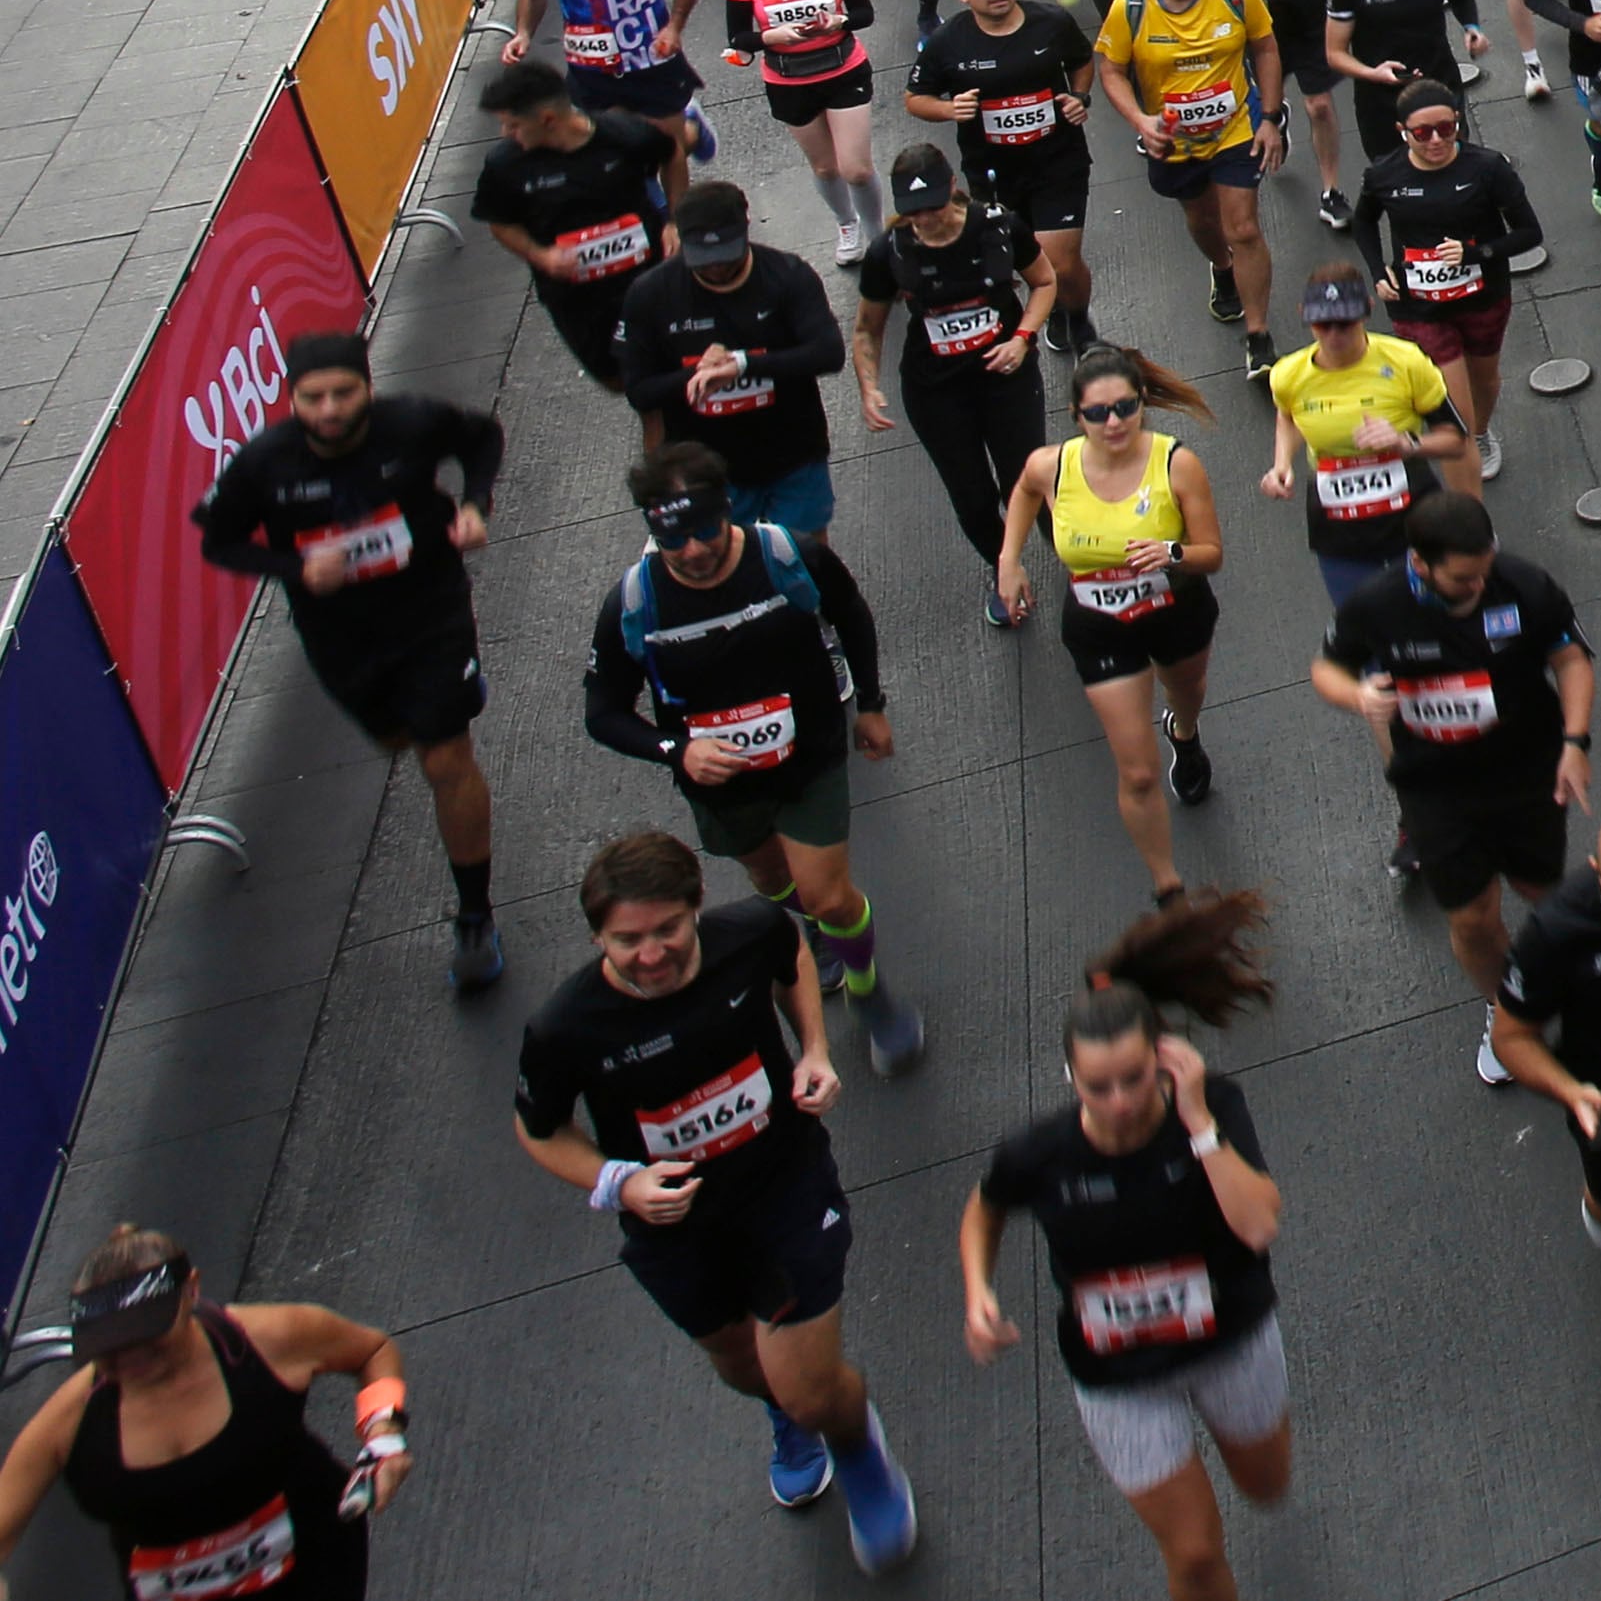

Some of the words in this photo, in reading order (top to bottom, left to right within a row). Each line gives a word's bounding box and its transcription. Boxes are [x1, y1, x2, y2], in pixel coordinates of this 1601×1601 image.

[993, 109, 1047, 129] 16555
[1176, 100, 1228, 122] 18926
[1417, 265, 1472, 285] 16624
[219, 282, 289, 440] Bci
[1329, 472, 1393, 499] 15341
[662, 1090, 757, 1150] 15164
